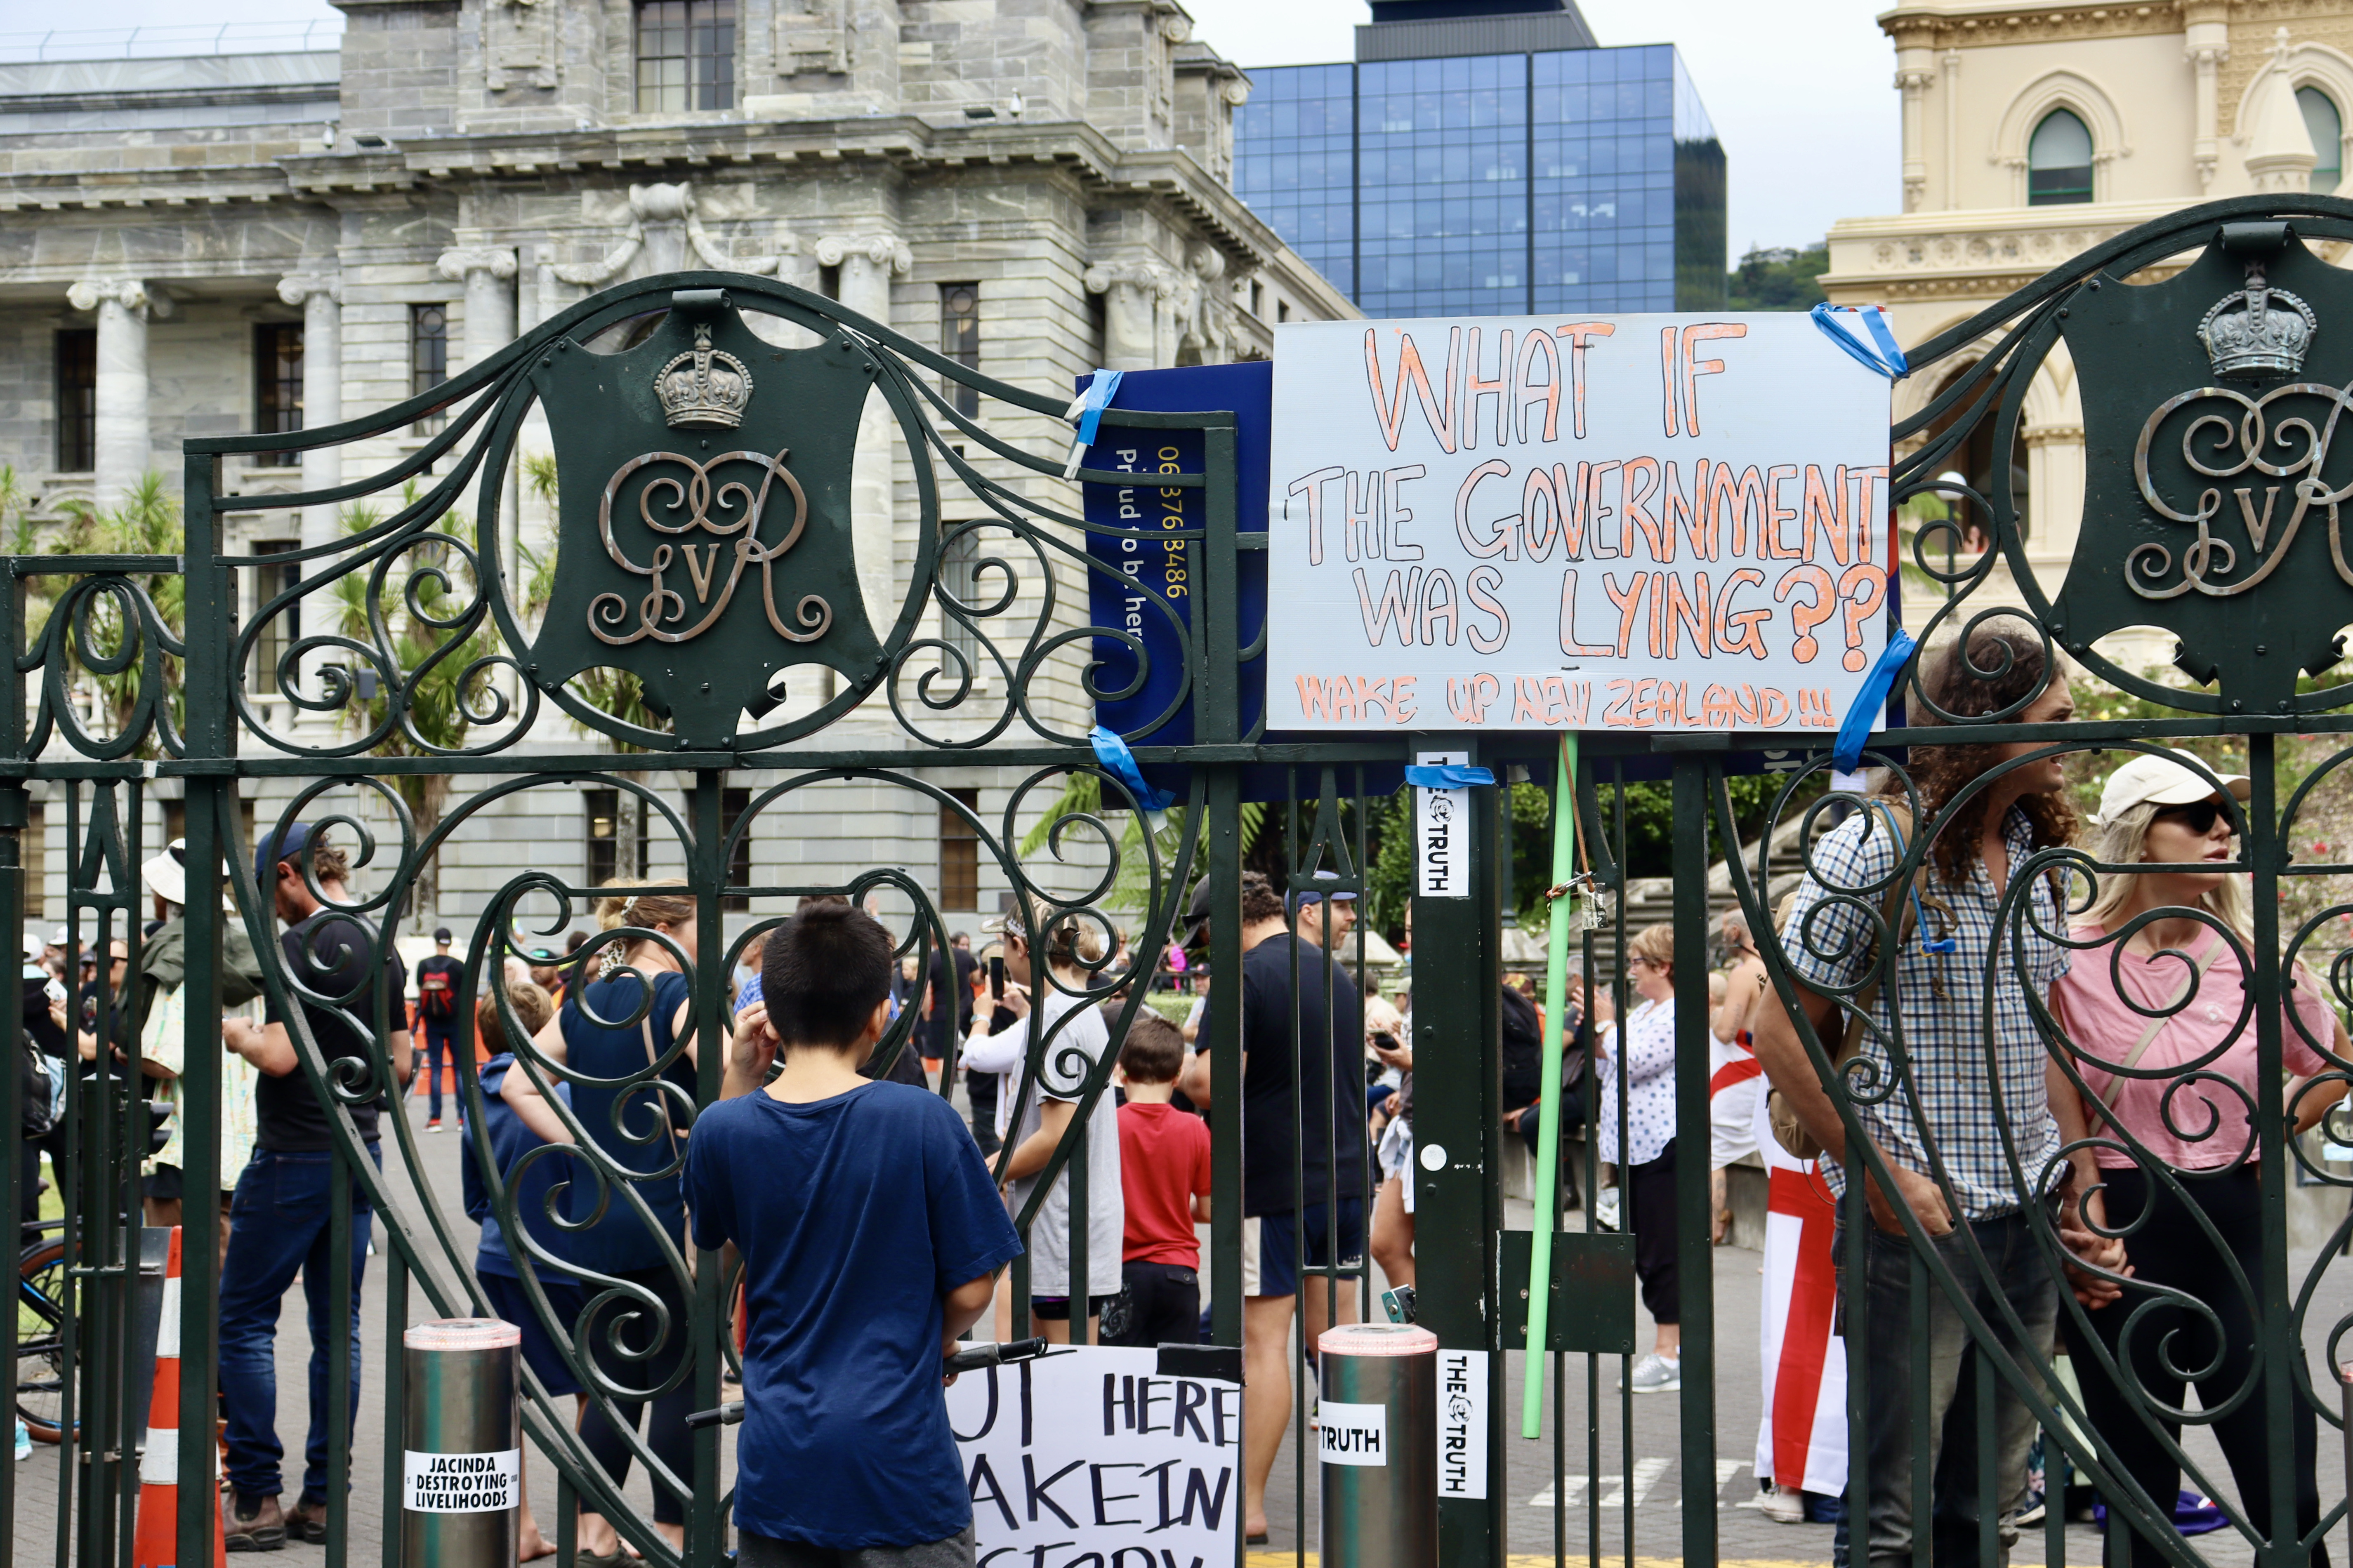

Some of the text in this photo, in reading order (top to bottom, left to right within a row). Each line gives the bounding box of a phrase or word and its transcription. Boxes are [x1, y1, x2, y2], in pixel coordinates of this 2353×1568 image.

[1364, 322, 1747, 454] WHAT IF
[1116, 449, 1141, 519] Prud
[1288, 456, 1889, 567] THE GOVERNMENT
[1163, 540, 1188, 598] 8486
[1353, 564, 1889, 673] WAS LYING??
[1296, 673, 1835, 728] WAKE UP NEW ZEALAND!!!
[1428, 757, 1448, 891] TE TRUTH
[944, 1349, 1240, 1448] UT HERE
[1446, 1356, 1467, 1492] THE TRUTH
[430, 1457, 496, 1473] JACINDA
[1321, 1425, 1379, 1453] TRUTH
[416, 1490, 507, 1509] LIVELIHOODS
[417, 1473, 507, 1491] DESTROYING
[969, 1453, 1231, 1534] AKEIN
